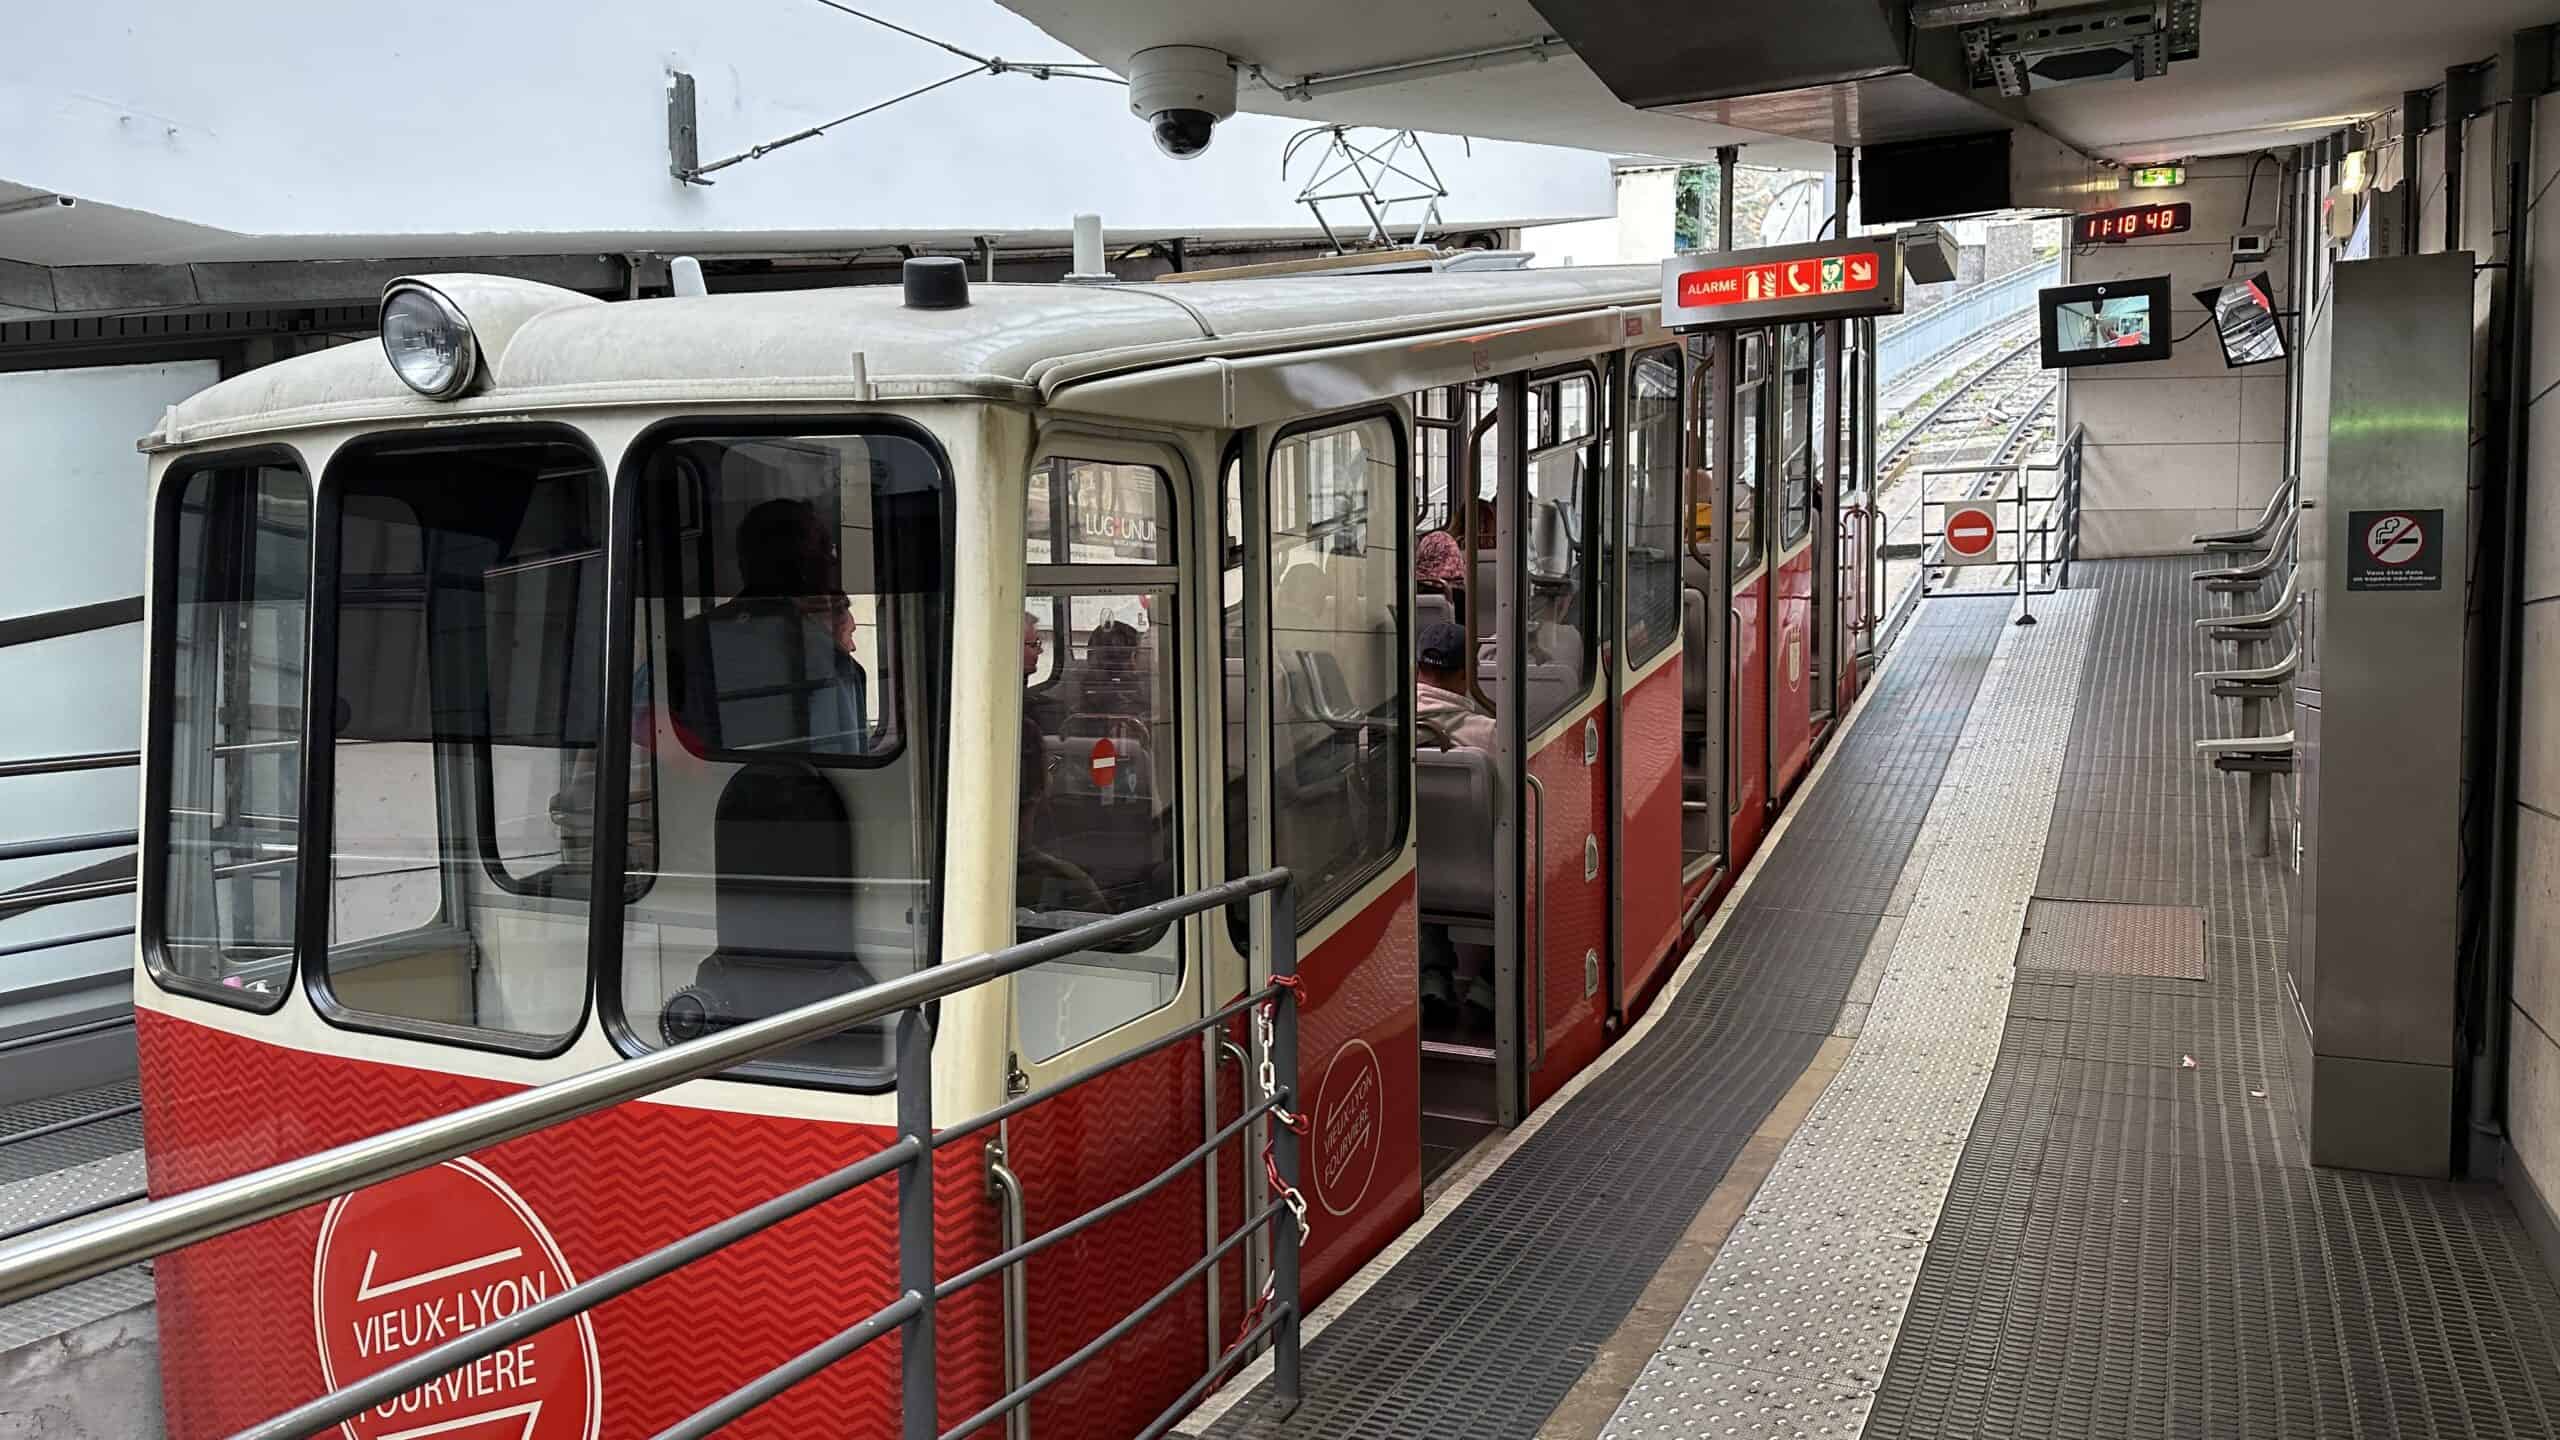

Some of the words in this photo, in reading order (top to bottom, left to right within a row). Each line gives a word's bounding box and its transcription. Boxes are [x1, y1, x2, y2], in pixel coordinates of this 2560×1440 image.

[1687, 278, 1738, 296] ALARME
[1324, 1071, 1372, 1153] VIEUX-LYON
[352, 1270, 547, 1358] VIEUX-LYON
[358, 1342, 537, 1423] URVIERE
